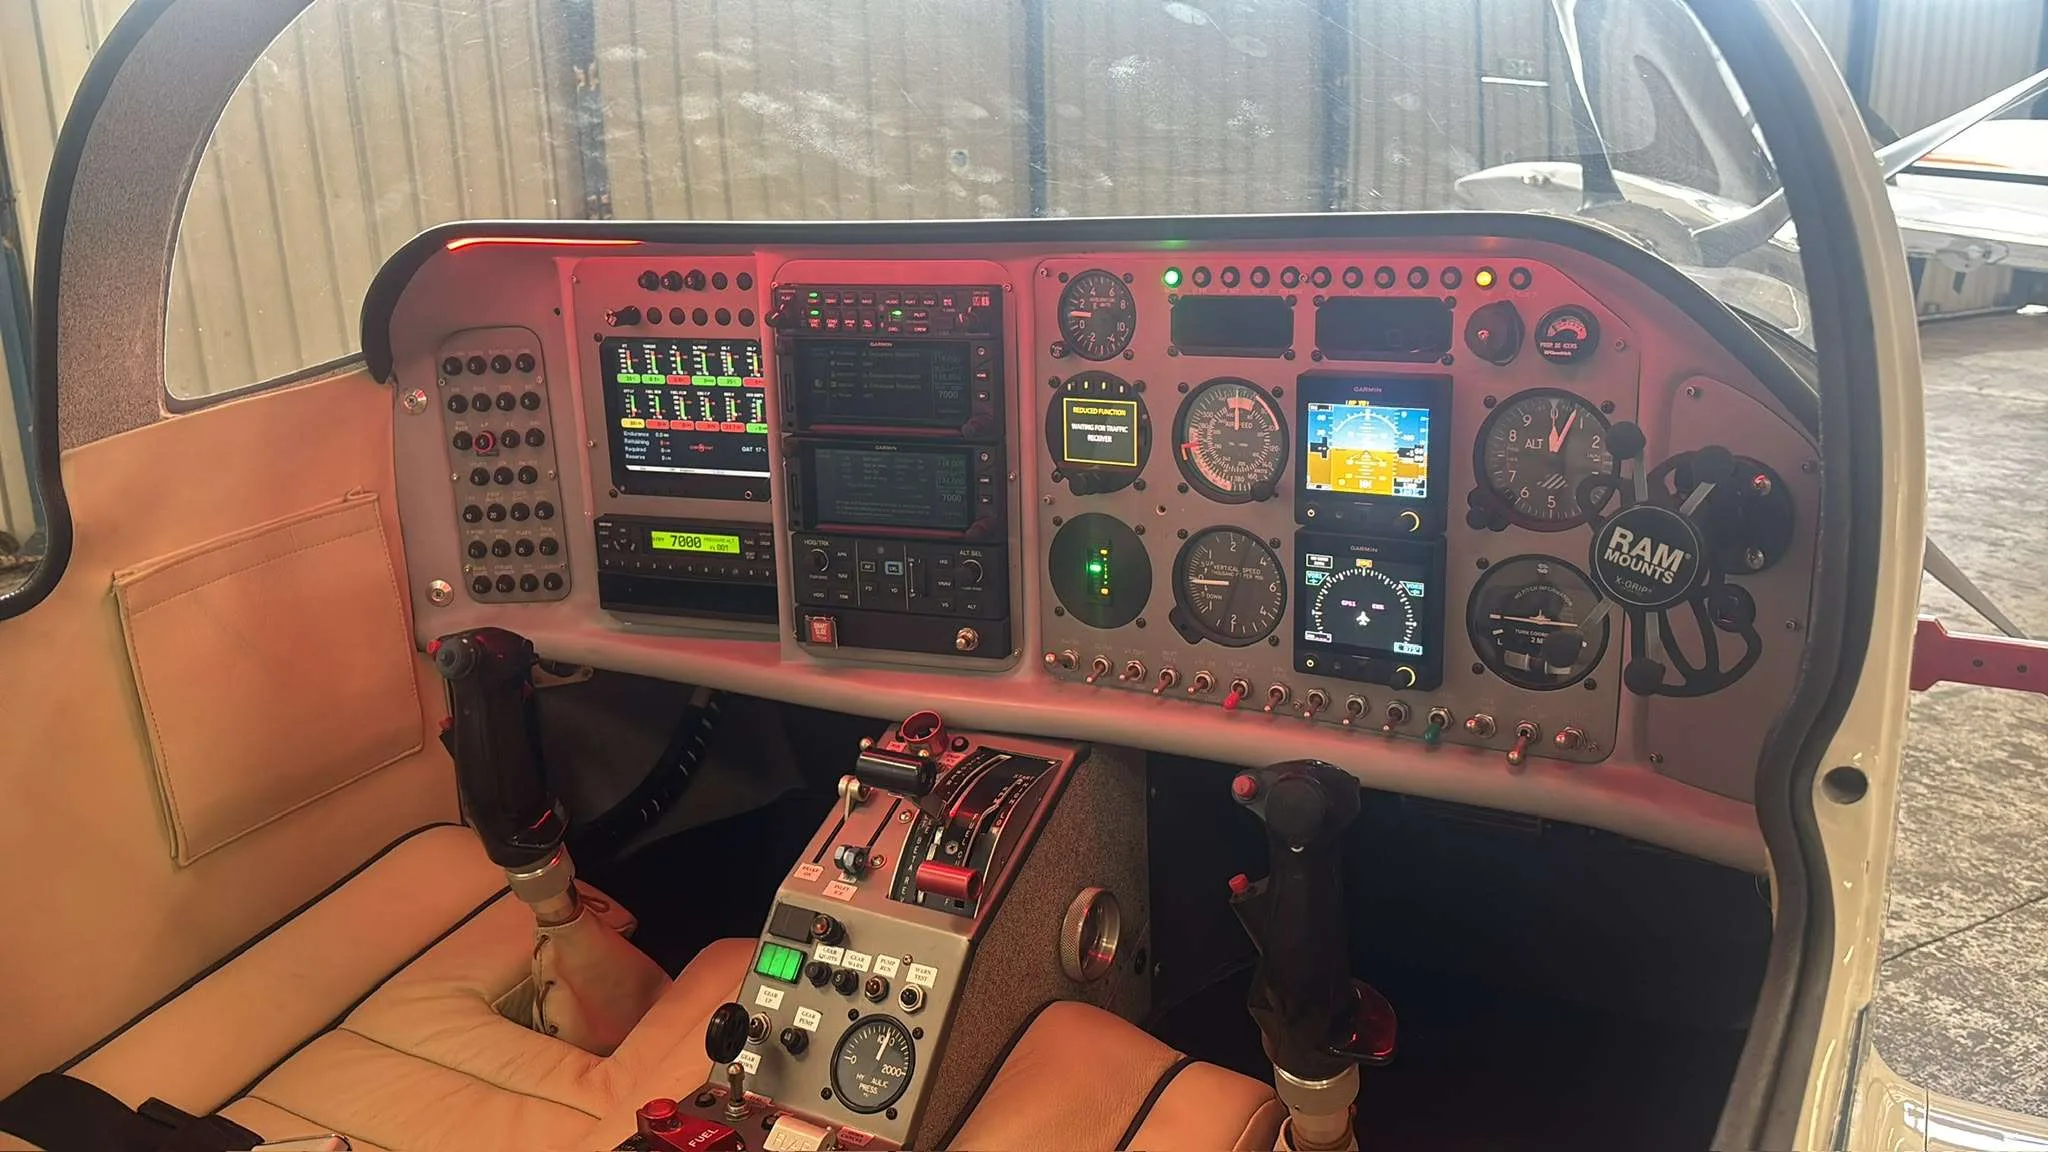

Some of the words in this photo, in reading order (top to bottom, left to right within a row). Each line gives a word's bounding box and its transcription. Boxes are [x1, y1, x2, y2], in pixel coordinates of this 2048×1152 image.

[1090, 286, 1097, 296] 4
[1108, 287, 1115, 297] 6
[1079, 299, 1086, 309] 2
[1119, 299, 1127, 310] 8
[1079, 319, 1086, 329] 0
[1116, 321, 1126, 332] 10
[1072, 406, 1098, 415] REDUCED
[1098, 408, 1127, 417] FUNCTION
[1522, 414, 1532, 427] 9
[1071, 423, 1095, 431] WAITING
[1095, 424, 1106, 432] FOR
[1106, 425, 1129, 433] TRAFFIC
[1087, 434, 1113, 443] RECEIVER
[1509, 429, 1517, 442] 8
[624, 438, 650, 446] Remaining
[1525, 439, 1544, 449] ALT
[1591, 435, 1601, 449] 2
[1508, 470, 1517, 483] 7
[1520, 486, 1530, 499] 6
[1547, 495, 1556, 509] 5
[669, 534, 702, 549] 7000
[804, 539, 830, 547] HDG/TRK
[1230, 541, 1238, 552] 2
[960, 549, 970, 557] ALT
[970, 550, 982, 558] SEL
[1608, 525, 1685, 573] RAM
[1260, 556, 1267, 567] 4
[1603, 547, 1676, 585] MOUNTS
[1213, 565, 1239, 573] VERTICAL
[1242, 567, 1261, 575] SPEED
[865, 584, 873, 592] FD
[1269, 582, 1277, 593] 6
[1610, 575, 1648, 593] X-GRIP
[1522, 584, 1538, 595] PITCH
[1538, 585, 1574, 607] INFORMATION
[1260, 605, 1267, 616] 4
[1230, 614, 1237, 625] 2
[1008, 782, 1029, 805] HIGH
[961, 812, 979, 846] FUEL
[908, 836, 922, 872] BETA
[850, 954, 865, 963] GEAR
[880, 958, 896, 966] PUMP
[847, 960, 863, 969] WARN
[880, 964, 892, 972] RUN
[915, 967, 931, 975] WARN
[835, 974, 840, 982] 5
[914, 974, 928, 982] TEST
[763, 990, 779, 998] GEAR
[801, 1010, 816, 1019] GEAR
[799, 1018, 814, 1027] PUMP
[877, 1034, 895, 1047] 100
[740, 1053, 755, 1062] GEAR
[850, 1055, 857, 1064] 0
[881, 1063, 902, 1078] 2000
[859, 1082, 878, 1095] PRESS
[688, 1128, 720, 1148] FUEL
